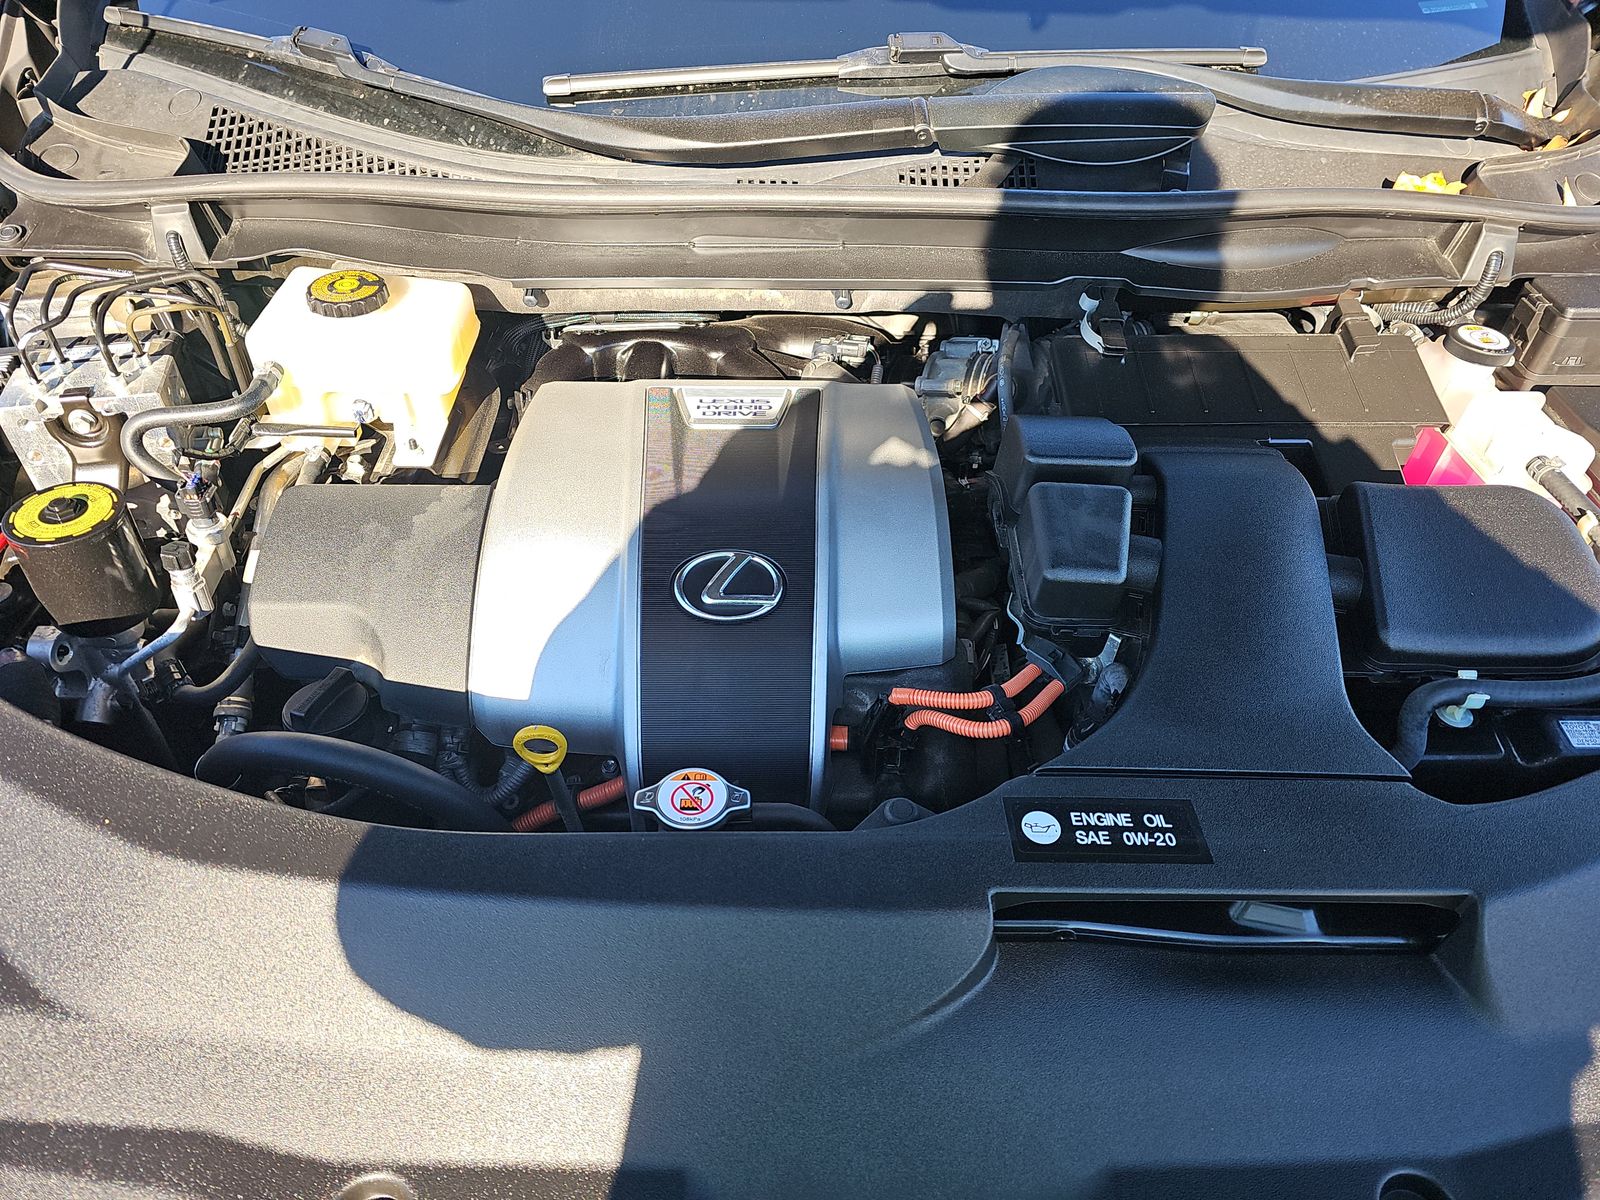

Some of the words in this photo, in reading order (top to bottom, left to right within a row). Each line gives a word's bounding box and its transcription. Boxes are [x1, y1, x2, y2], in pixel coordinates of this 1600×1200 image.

[1069, 811, 1134, 827] ENGINE
[1142, 813, 1173, 828] OIL
[1075, 830, 1112, 846] SAE
[1122, 831, 1177, 847] 0W-20
